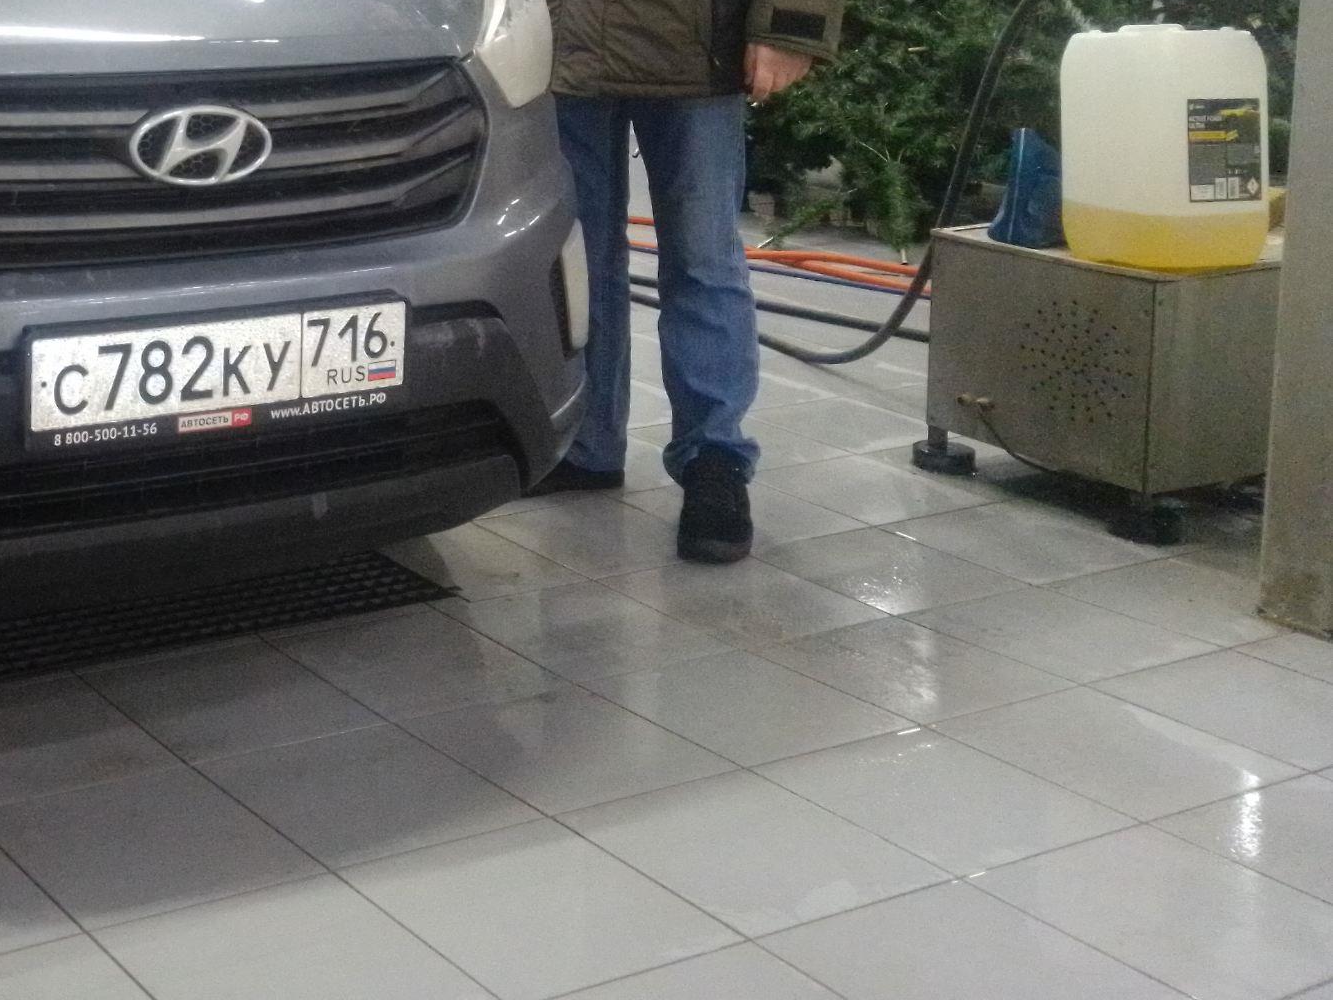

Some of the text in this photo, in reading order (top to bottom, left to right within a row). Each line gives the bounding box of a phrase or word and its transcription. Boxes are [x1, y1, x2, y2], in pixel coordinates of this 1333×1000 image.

[307, 311, 389, 367] 716
[327, 366, 365, 385] RUS
[65, 422, 157, 445] 800-500-11-56
